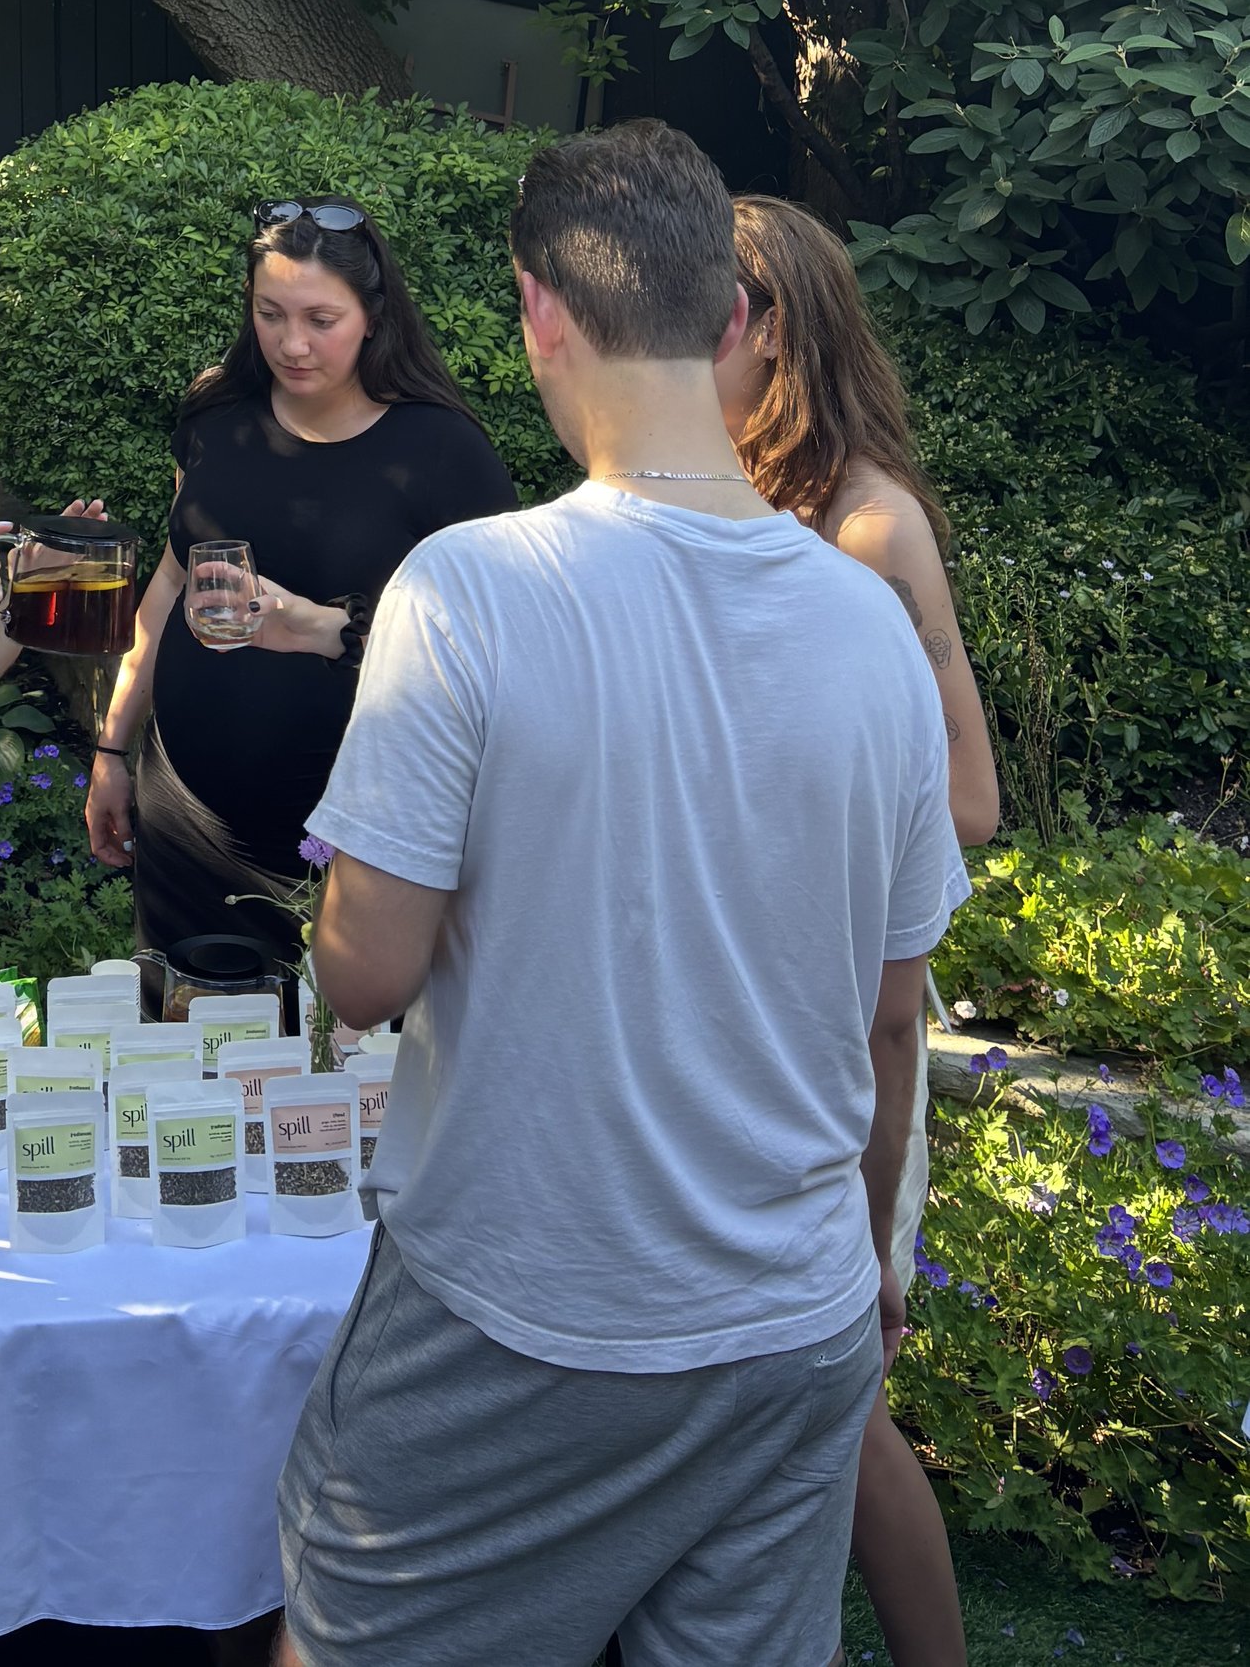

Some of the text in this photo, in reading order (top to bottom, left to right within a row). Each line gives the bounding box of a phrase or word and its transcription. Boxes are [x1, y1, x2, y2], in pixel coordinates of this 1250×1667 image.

[241, 1078, 263, 1096] pill
[122, 1103, 148, 1127] spil
[162, 1128, 196, 1153] spill
[278, 1115, 312, 1141] spill
[22, 1136, 55, 1161] spill
